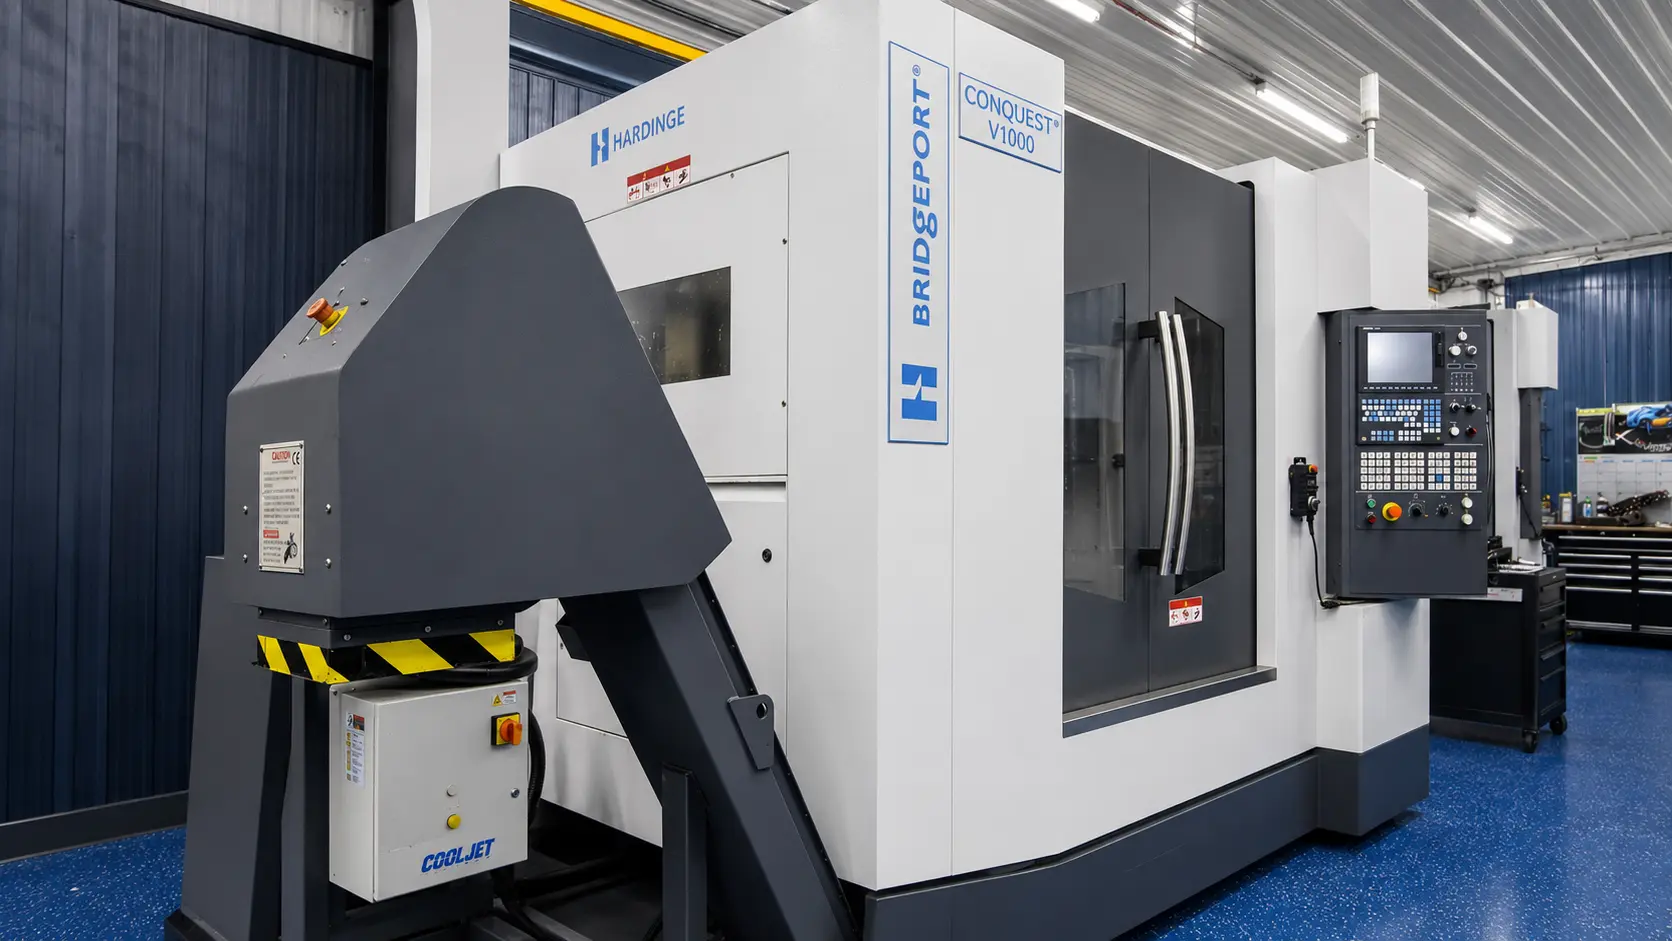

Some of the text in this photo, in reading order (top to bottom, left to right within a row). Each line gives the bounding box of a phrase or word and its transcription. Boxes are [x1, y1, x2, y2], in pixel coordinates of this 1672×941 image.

[613, 105, 686, 152] HARDINGE
[988, 119, 1035, 154] V1000
[421, 838, 495, 872] COOLJET
